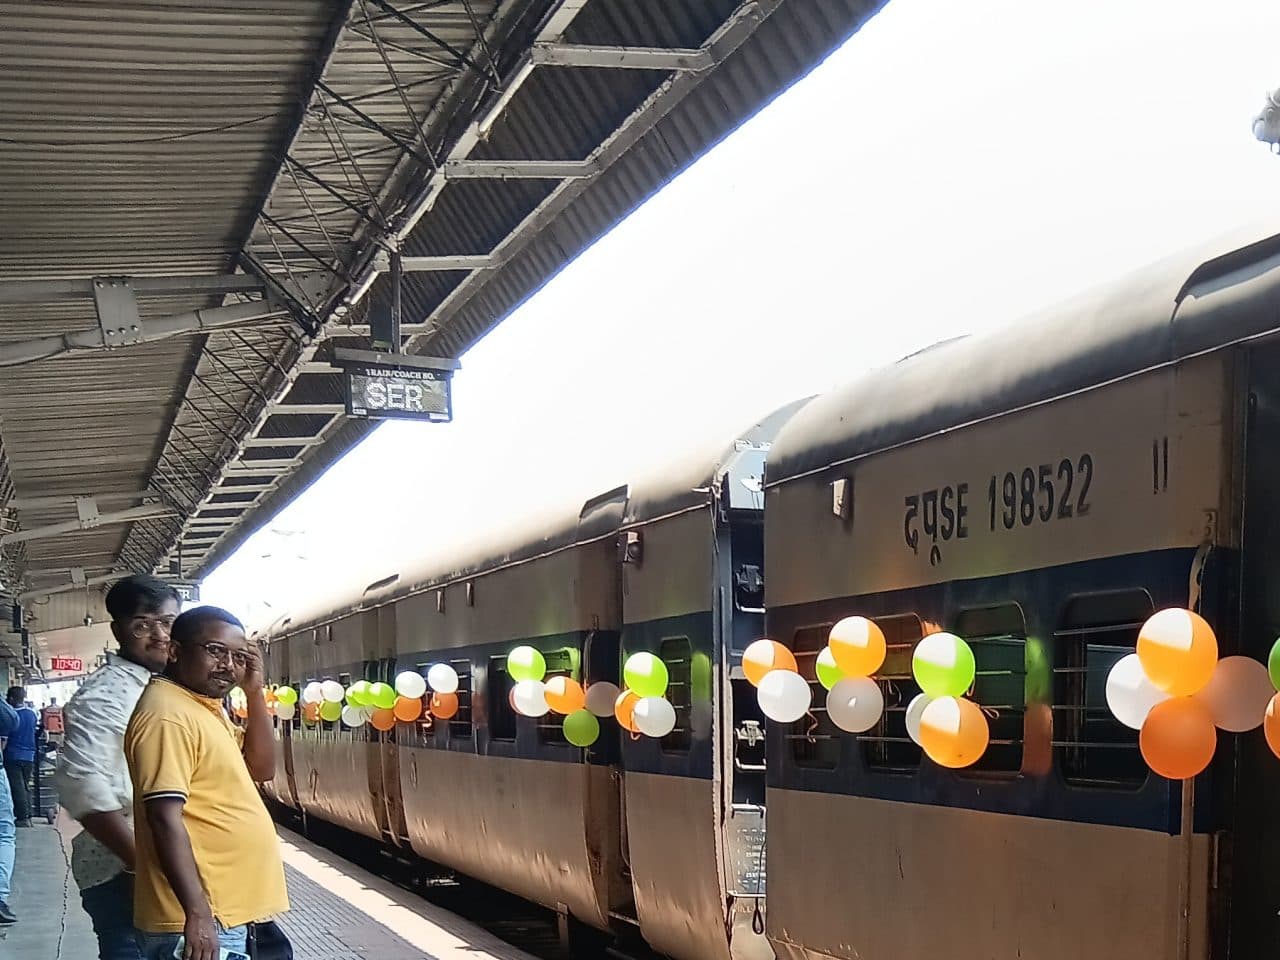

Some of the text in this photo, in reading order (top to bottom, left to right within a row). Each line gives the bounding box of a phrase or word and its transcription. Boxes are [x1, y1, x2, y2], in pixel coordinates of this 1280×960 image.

[366, 369, 421, 379] TRAIN/COACH
[367, 382, 423, 409] SER
[988, 453, 1094, 533] 198522
[56, 659, 80, 670] 10:40
